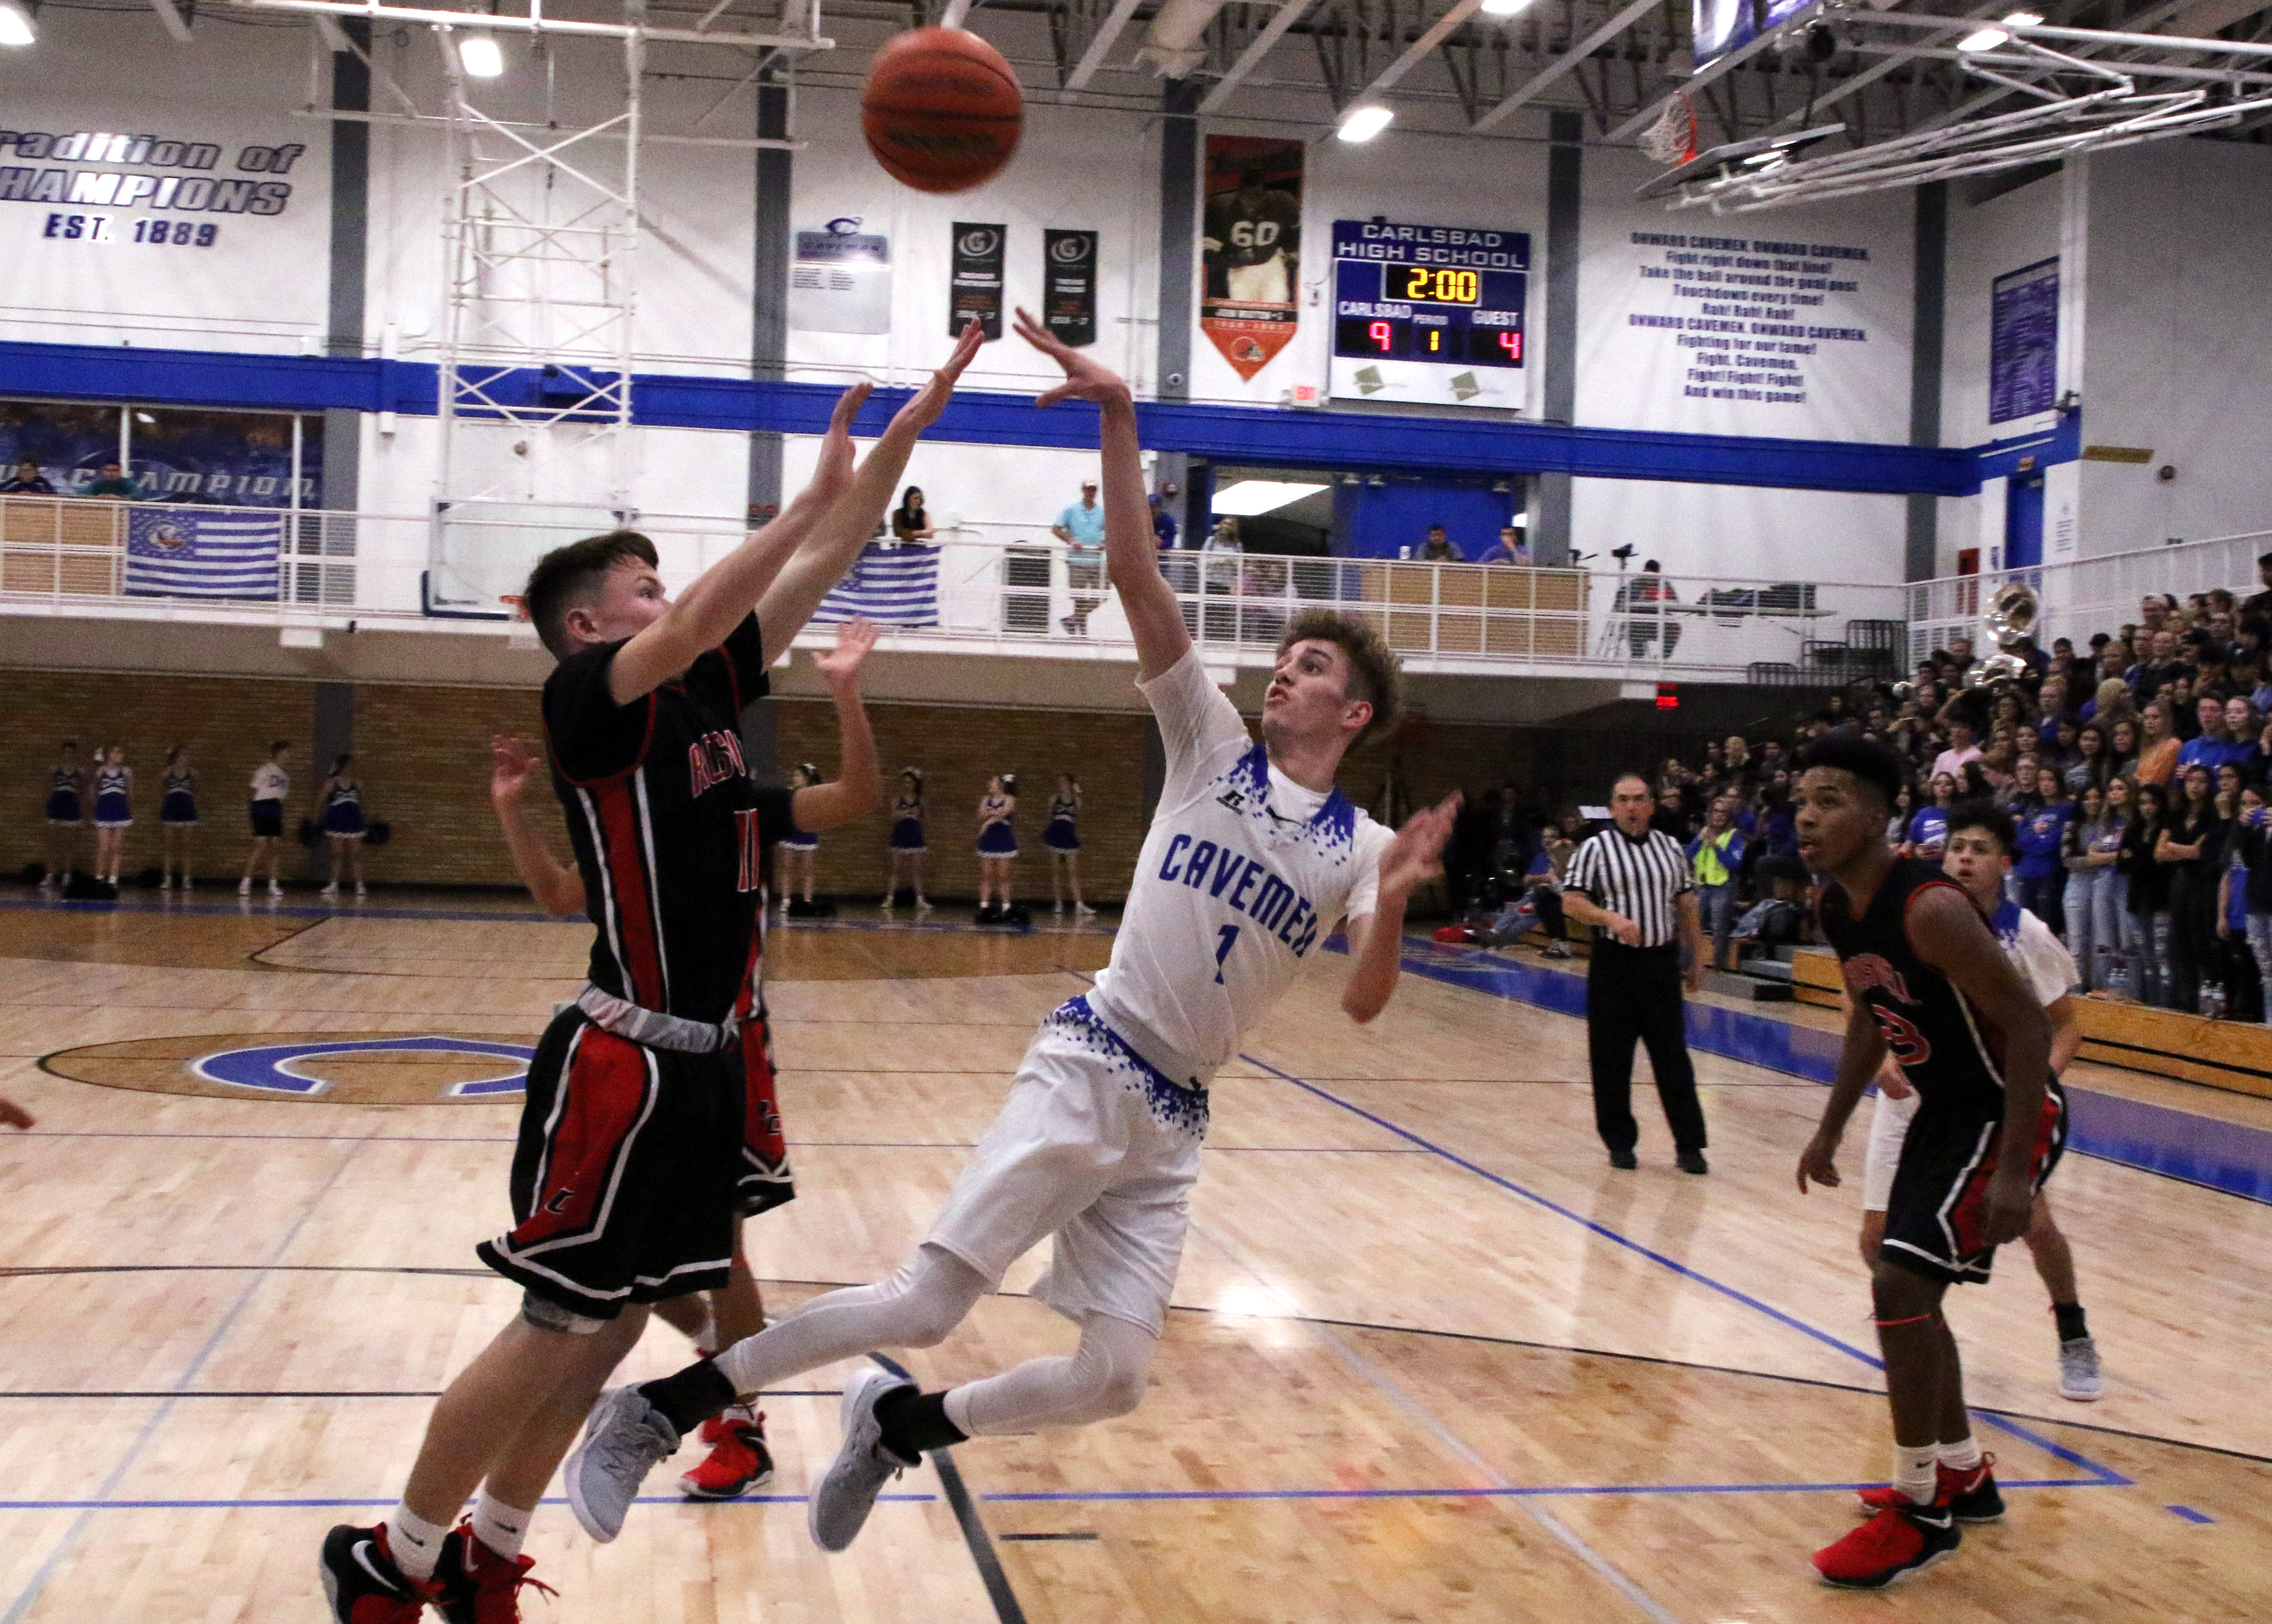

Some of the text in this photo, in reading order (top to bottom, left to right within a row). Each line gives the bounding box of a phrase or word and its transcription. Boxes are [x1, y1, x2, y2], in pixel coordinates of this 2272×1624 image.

[0, 131, 305, 174] radition of
[0, 166, 292, 215] HAMPIONS
[45, 214, 218, 247] EST. 1889
[1231, 221, 1280, 247] 60
[1362, 224, 1503, 247] CARLSBAD
[1338, 242, 1524, 268] HIGH SCHOOL
[1631, 232, 1687, 247] ONWARD
[1754, 240, 1807, 256] ONWARD
[1667, 251, 1698, 265] Fight
[1702, 254, 1733, 267] right
[1737, 256, 1770, 269] down
[1407, 268, 1477, 301] 2:00
[1640, 265, 1670, 278] Take
[1673, 268, 1694, 280] the
[1697, 270, 1722, 282] ball
[1726, 273, 1770, 286] around
[1774, 275, 1795, 287] the
[1798, 278, 1826, 289] goal
[1673, 284, 1748, 300] Touchdown
[1752, 292, 1786, 304] every
[1338, 301, 1412, 319] CARLSBAD
[1412, 314, 1449, 325] PERIOD
[1471, 310, 1519, 326] GUEST
[1701, 303, 1795, 321] Rah! Rah! Rah!
[1370, 321, 1391, 351] 9
[1629, 313, 1684, 329] ONWARD
[1752, 322, 1805, 337] ONWARD
[1430, 331, 1439, 351] 1
[1499, 332, 1521, 360] 4
[1677, 334, 1730, 350] Fighting
[1733, 337, 1752, 349] for
[1685, 385, 1708, 398] And
[1712, 387, 1735, 399] win
[1738, 388, 1762, 401] this
[734, 808, 759, 892] 11
[1158, 833, 1317, 958] CAVEMEN
[1215, 924, 1240, 985] 1
